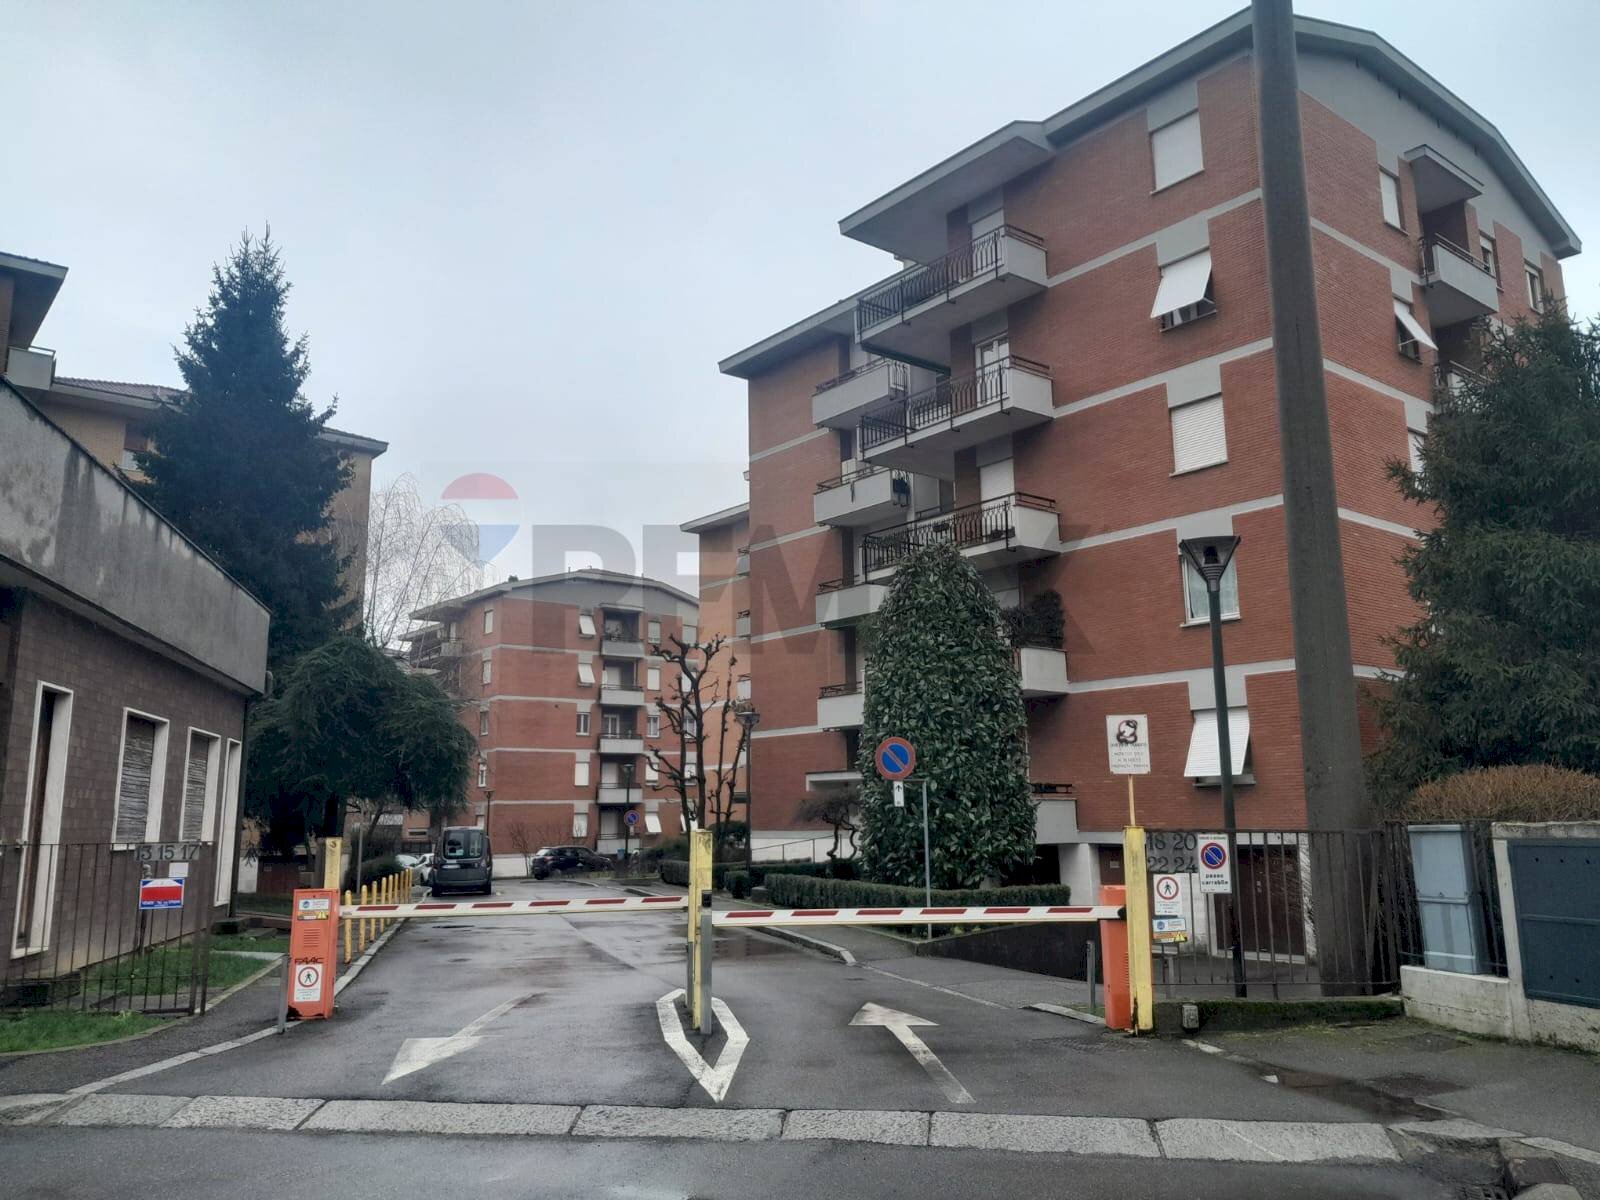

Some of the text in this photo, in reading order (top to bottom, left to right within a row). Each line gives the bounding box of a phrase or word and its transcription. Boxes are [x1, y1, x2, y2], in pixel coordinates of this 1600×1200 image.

[1146, 832, 1197, 850] 18 20
[136, 844, 199, 861] 13 15 17
[1147, 855, 1198, 873] 22 24
